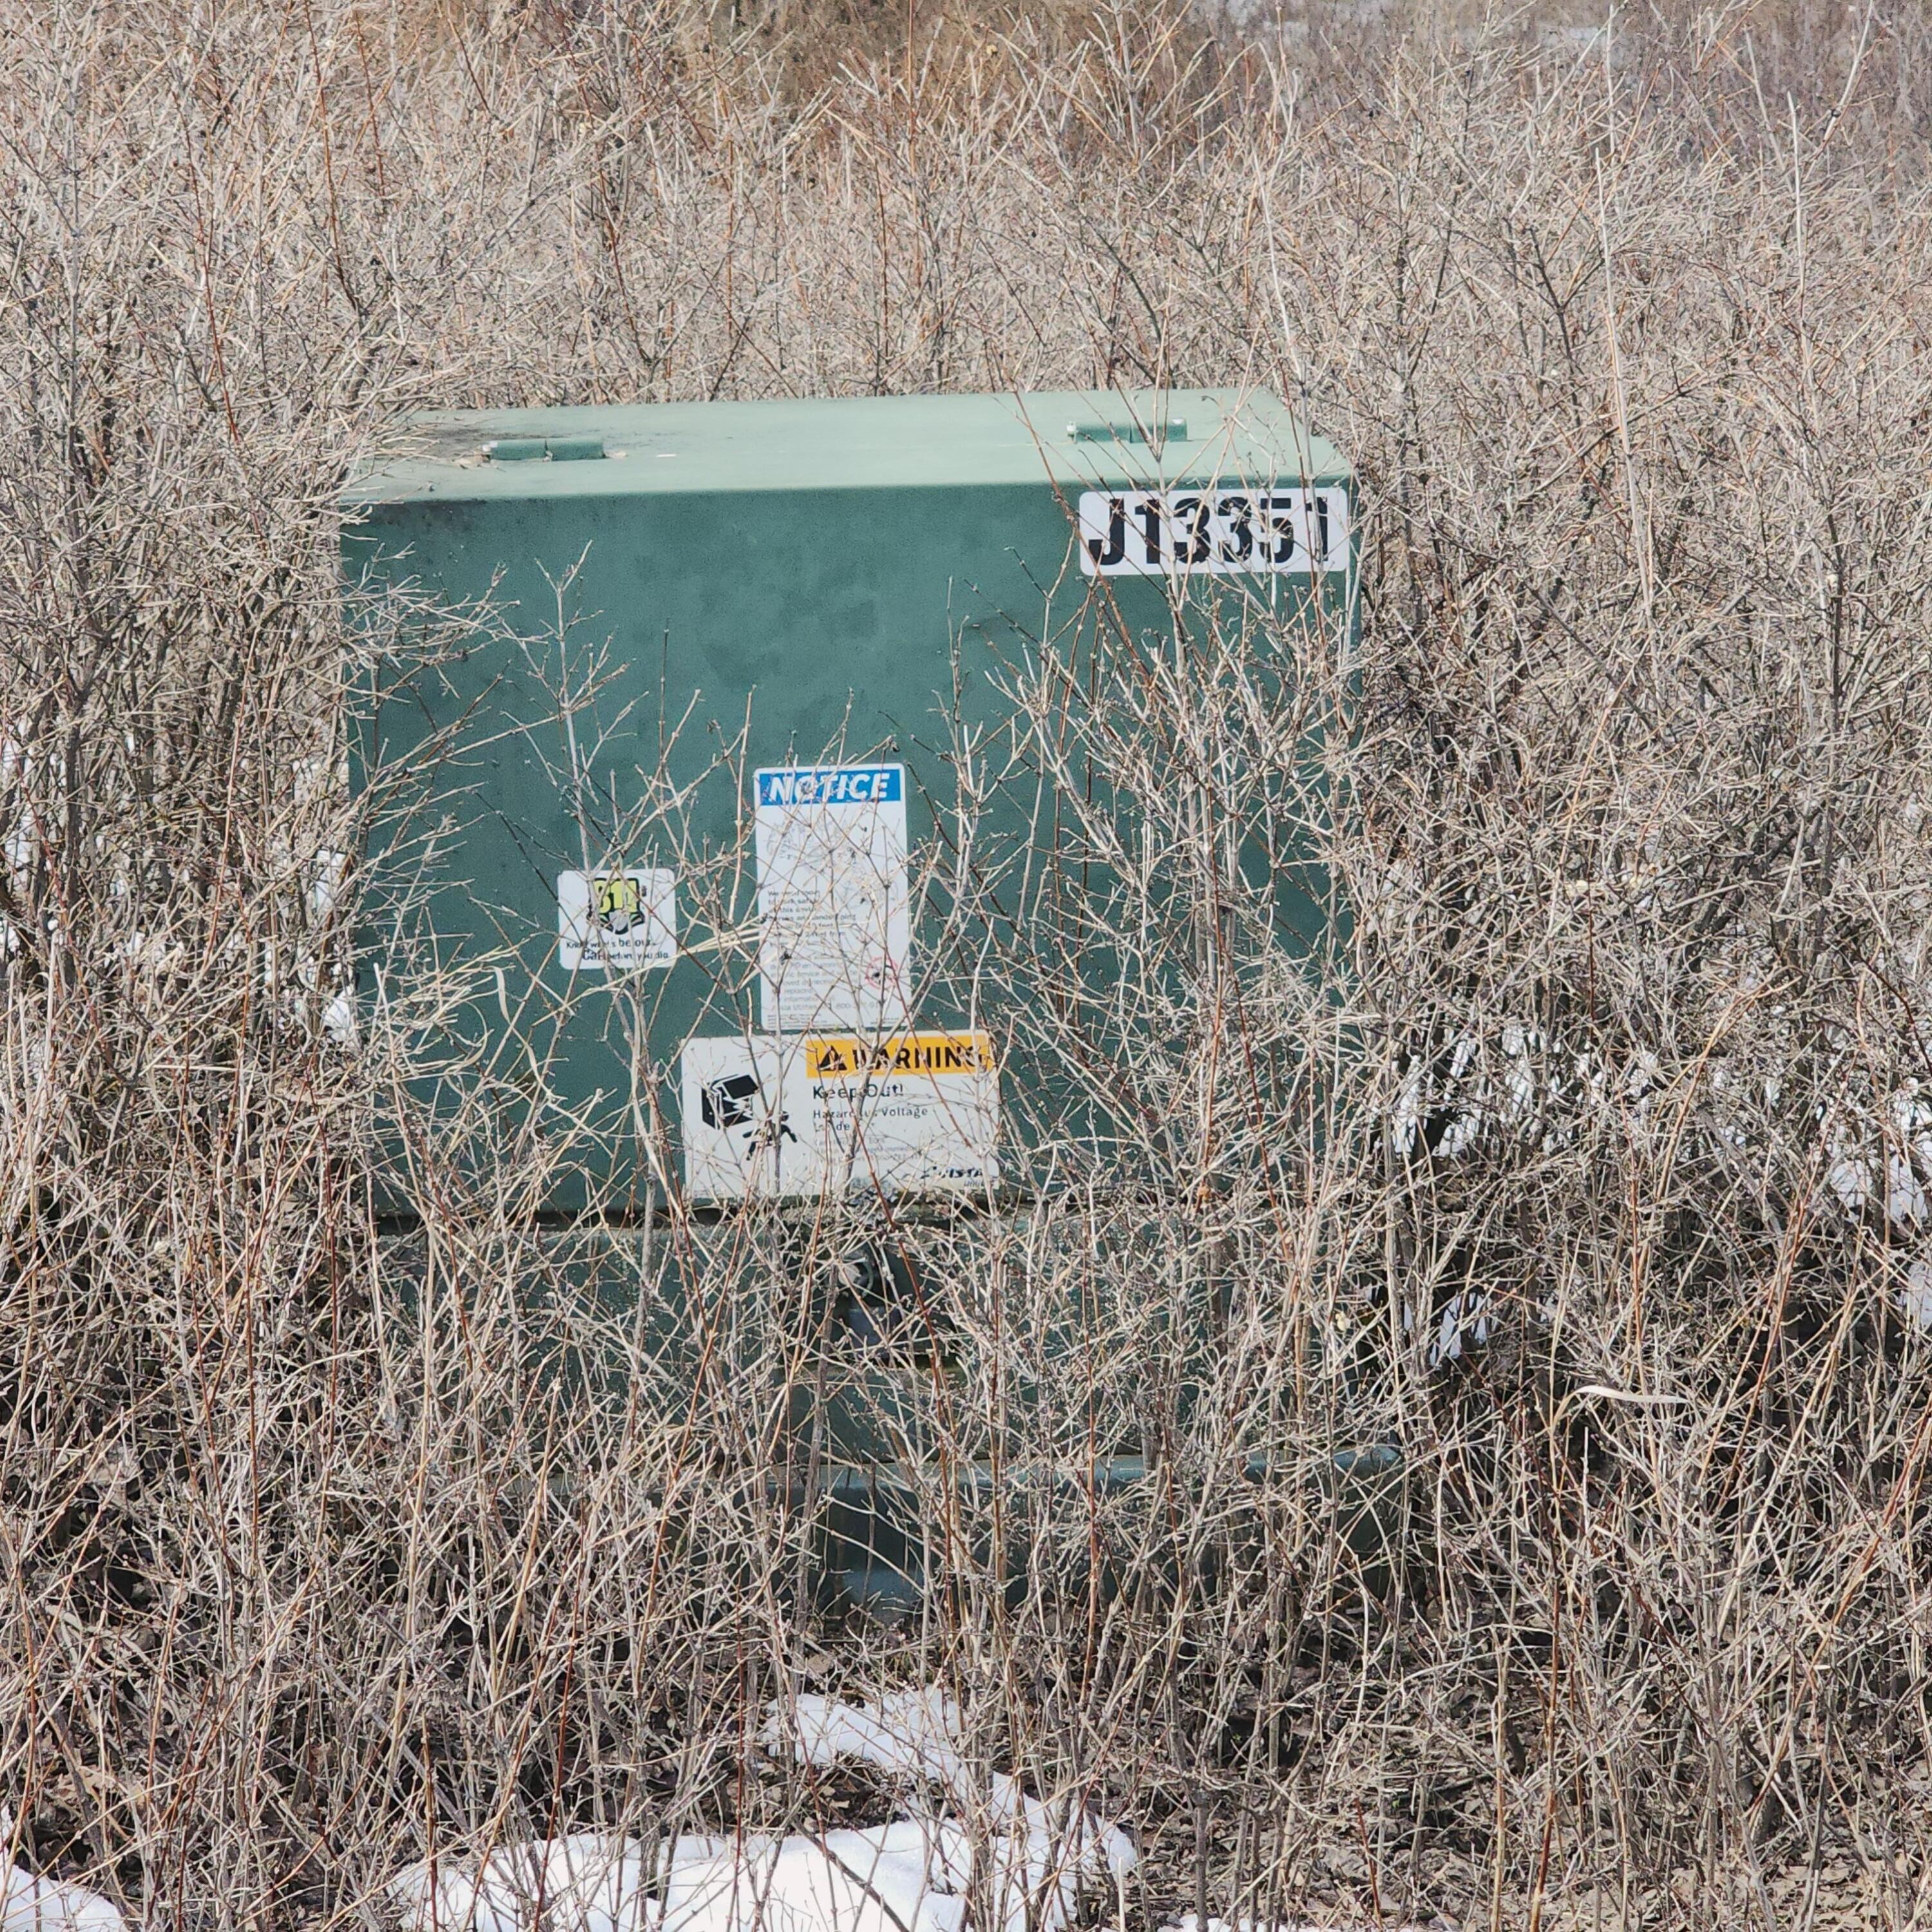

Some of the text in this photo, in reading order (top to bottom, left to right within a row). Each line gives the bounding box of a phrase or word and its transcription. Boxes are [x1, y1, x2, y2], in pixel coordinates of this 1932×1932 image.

[1088, 496, 1329, 566] J13351
[769, 772, 891, 802] NOTICE
[813, 1083, 904, 1102] Keep Out!
[882, 1107, 928, 1119] Voltage
